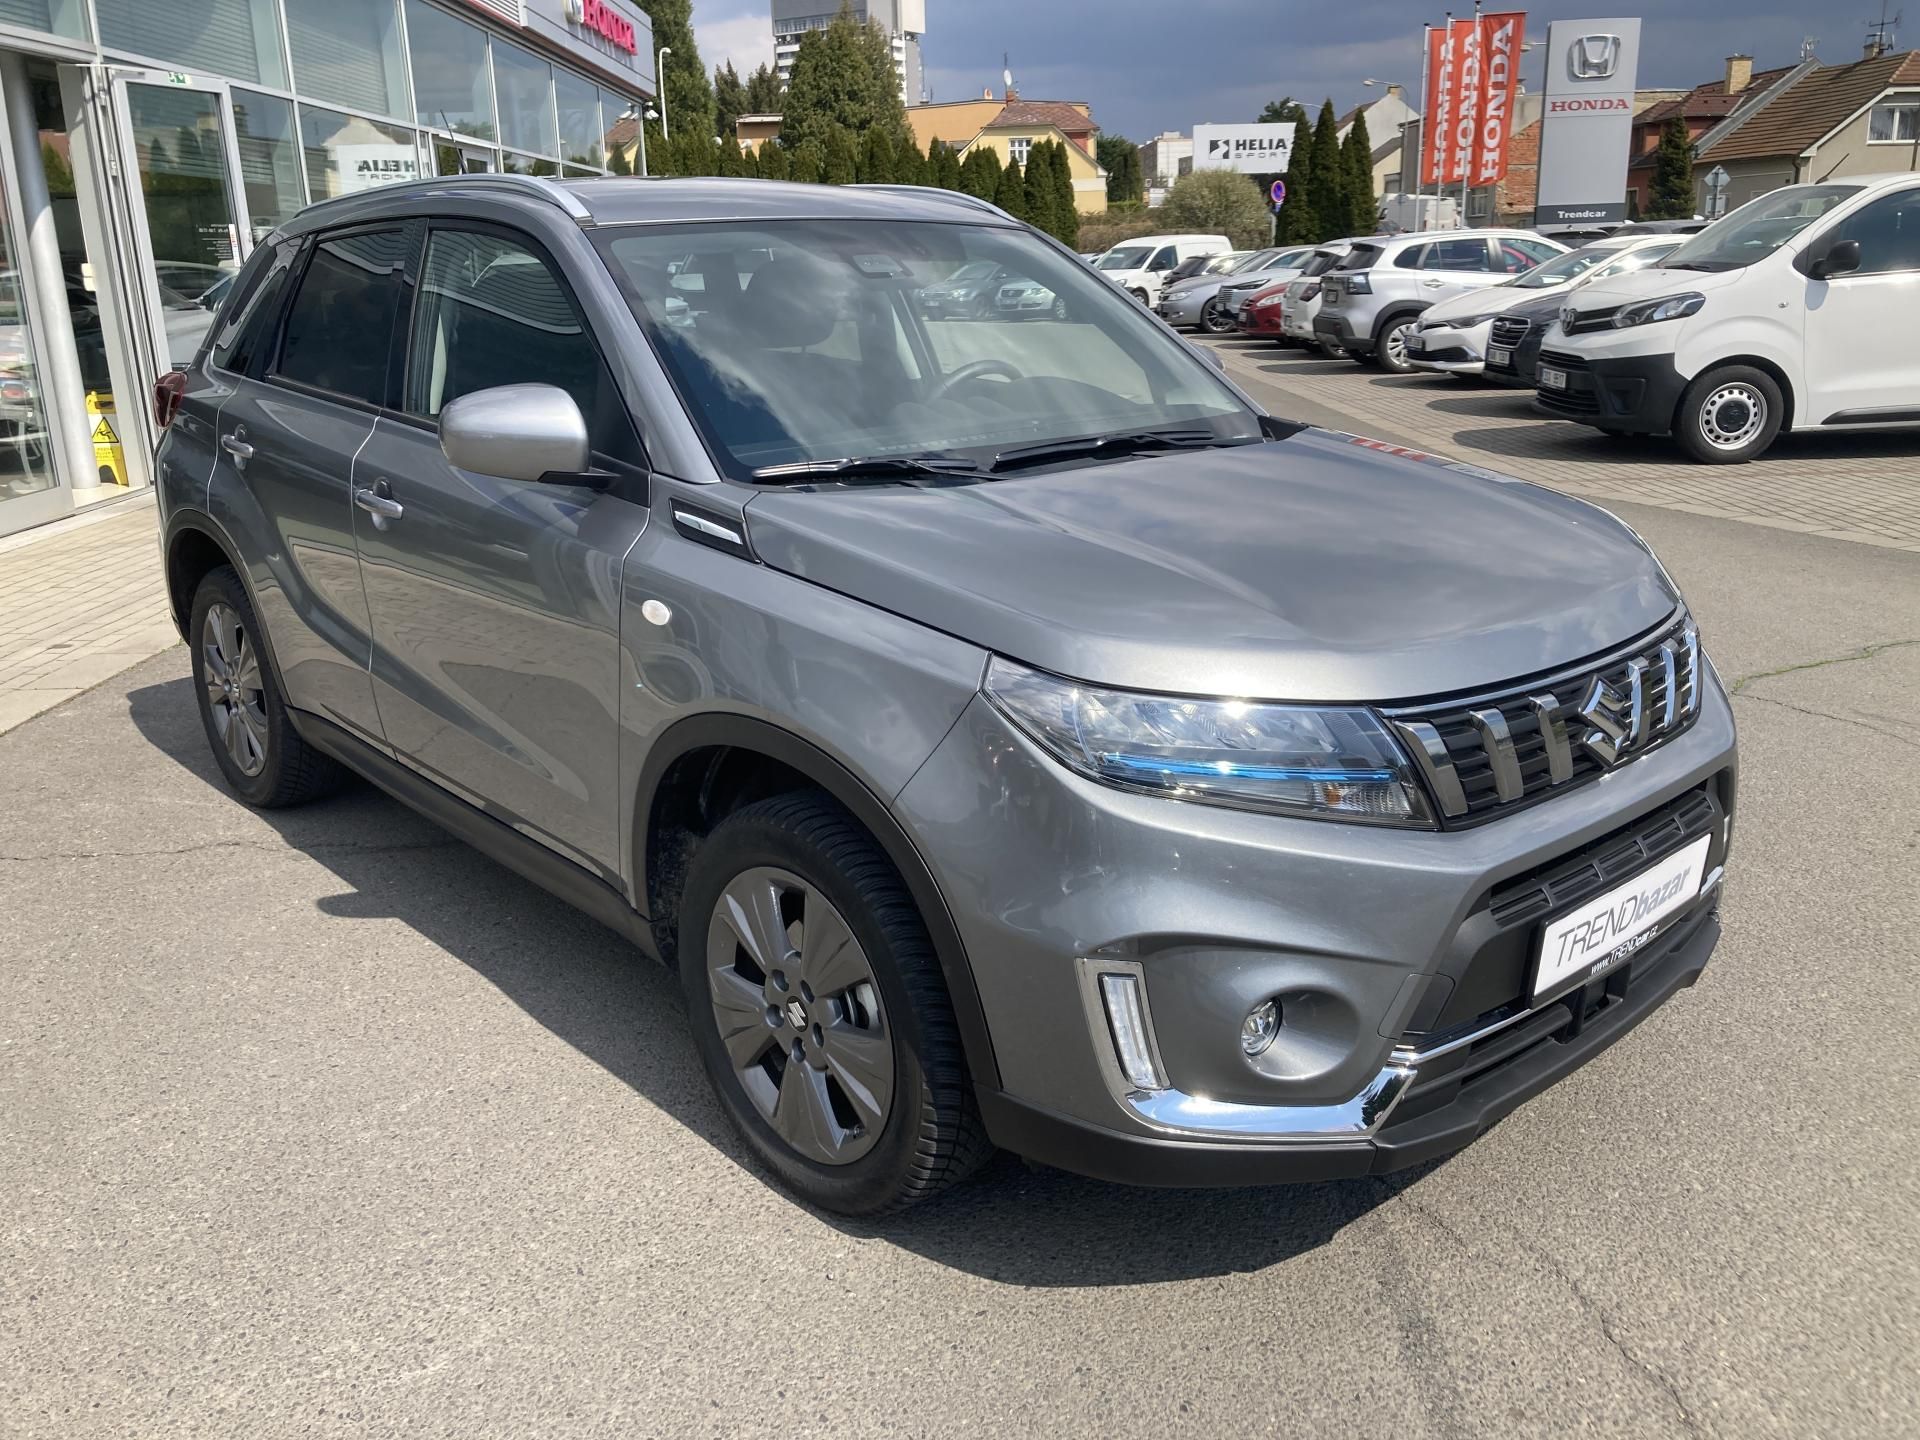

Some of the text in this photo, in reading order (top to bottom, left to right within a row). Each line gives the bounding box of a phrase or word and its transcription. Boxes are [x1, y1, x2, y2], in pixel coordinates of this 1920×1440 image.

[583, 0, 637, 55] HONDA
[1453, 27, 1482, 178] HONDA
[1480, 19, 1514, 181] HONDA
[1550, 99, 1629, 112] HONDA
[1236, 139, 1287, 150] HELIA
[1558, 210, 1607, 219] Trendcar
[1557, 865, 1691, 967] TRENDbazar
